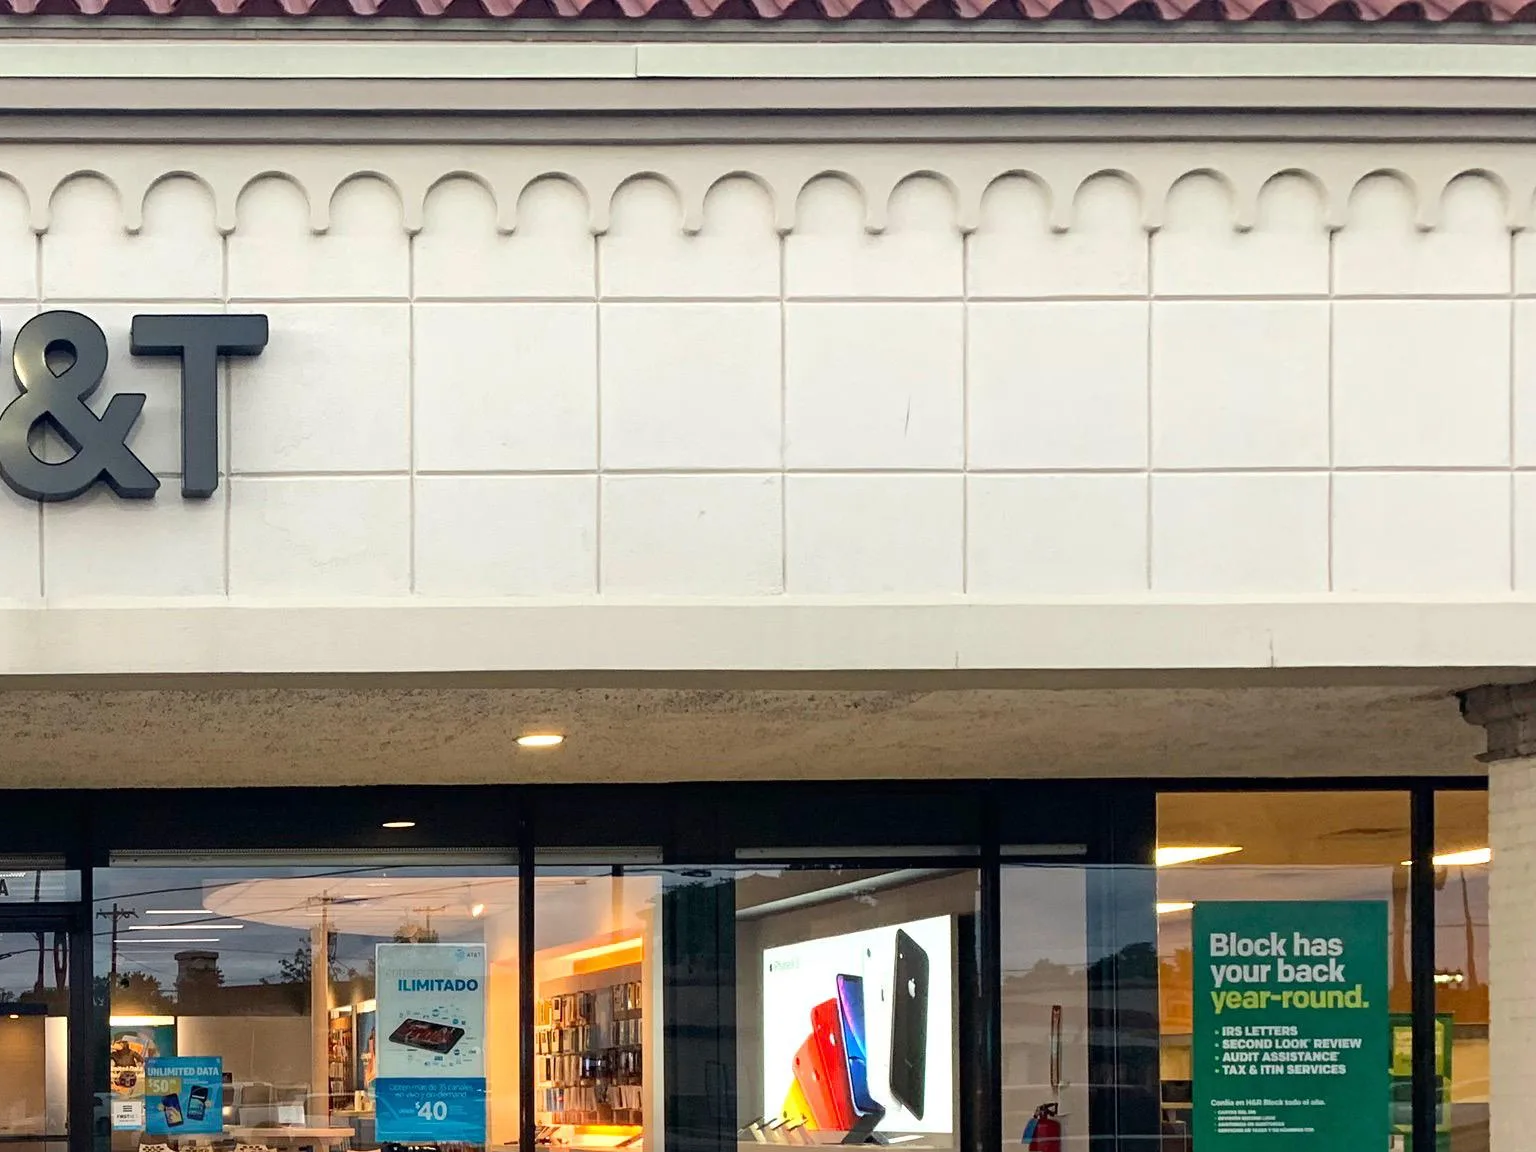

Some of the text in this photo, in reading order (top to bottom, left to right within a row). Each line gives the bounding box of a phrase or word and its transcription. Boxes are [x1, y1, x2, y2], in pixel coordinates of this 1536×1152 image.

[1210, 932, 1344, 957] Block has
[1210, 958, 1346, 988] your back
[398, 979, 479, 992] ILIMITADO
[1211, 984, 1369, 1014] year-round.
[1222, 1026, 1298, 1036] IRS LETTERS
[1222, 1039, 1272, 1049] SECOND
[1313, 1038, 1362, 1049] REVIEW
[1222, 1052, 1259, 1062] AUDIT
[147, 1067, 195, 1076] UNLIMITED
[197, 1066, 219, 1076] DATA
[1223, 1064, 1346, 1075] TAX & ITIN SERVICES
